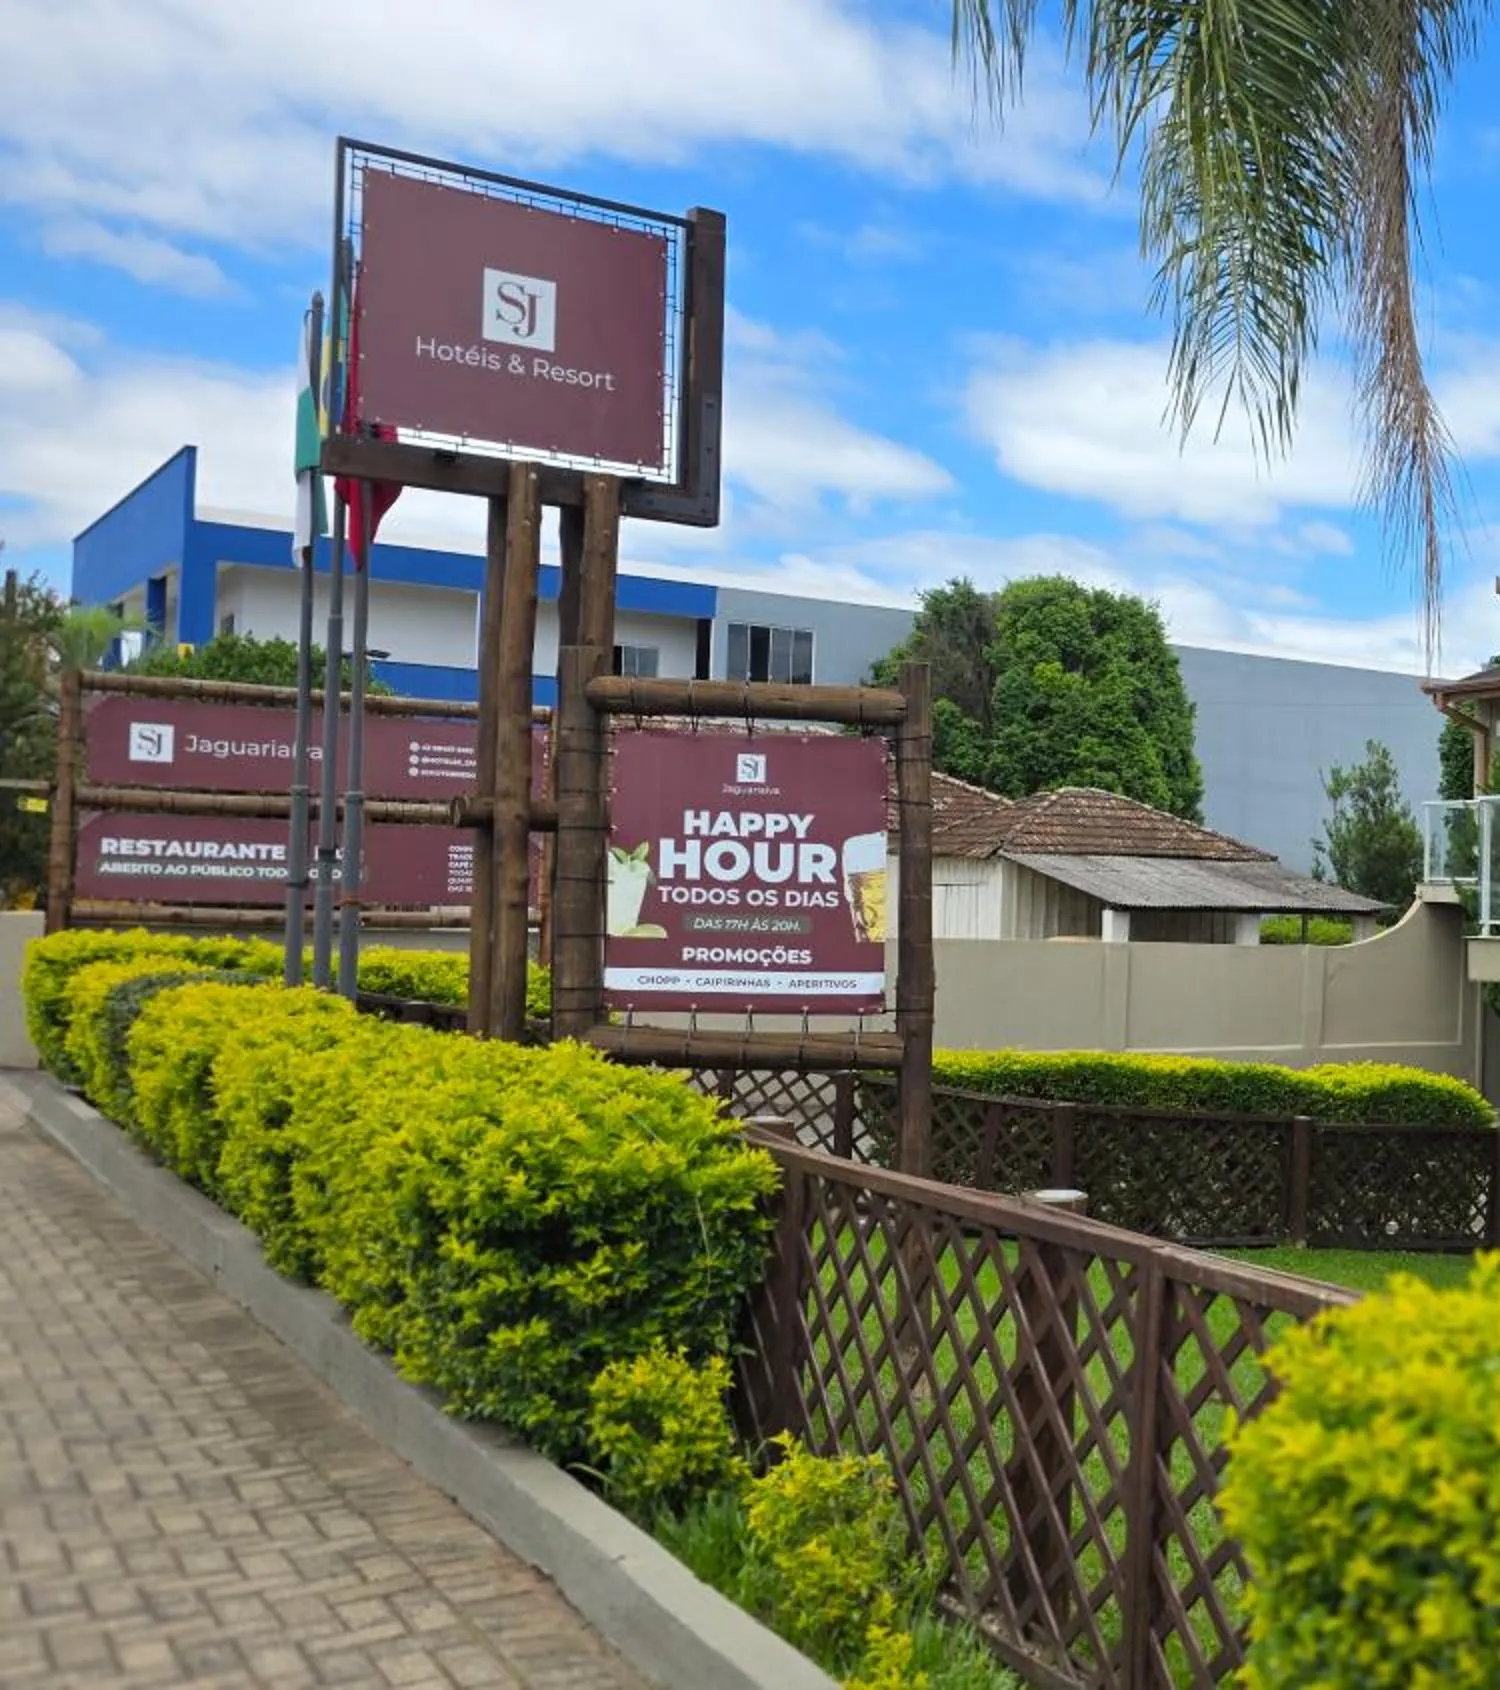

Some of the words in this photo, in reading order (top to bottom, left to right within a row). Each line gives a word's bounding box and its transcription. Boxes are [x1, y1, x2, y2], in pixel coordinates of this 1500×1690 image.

[496, 281, 543, 338] SJ
[416, 335, 501, 370] Hotéis
[508, 354, 526, 373] &
[533, 358, 616, 391] Resort
[138, 727, 163, 757] SJ
[185, 734, 324, 761] Jaguariaía
[683, 809, 816, 839] HAPPY
[101, 837, 287, 861] RESTAURANTE
[658, 838, 838, 884] HOUR
[99, 862, 162, 875] ABERTO
[164, 864, 190, 876] AO
[191, 863, 255, 878] PÚBLICO
[258, 867, 289, 879] TOD
[657, 886, 741, 906] TODOS
[746, 889, 779, 907] OS
[785, 889, 840, 908] DIAS
[693, 917, 723, 930] DAS
[682, 945, 813, 967] PROMOÇÕES
[637, 975, 681, 986] CHOPP
[695, 976, 772, 989] CAIPIRINHAS
[788, 978, 858, 990] APERITIVOS
